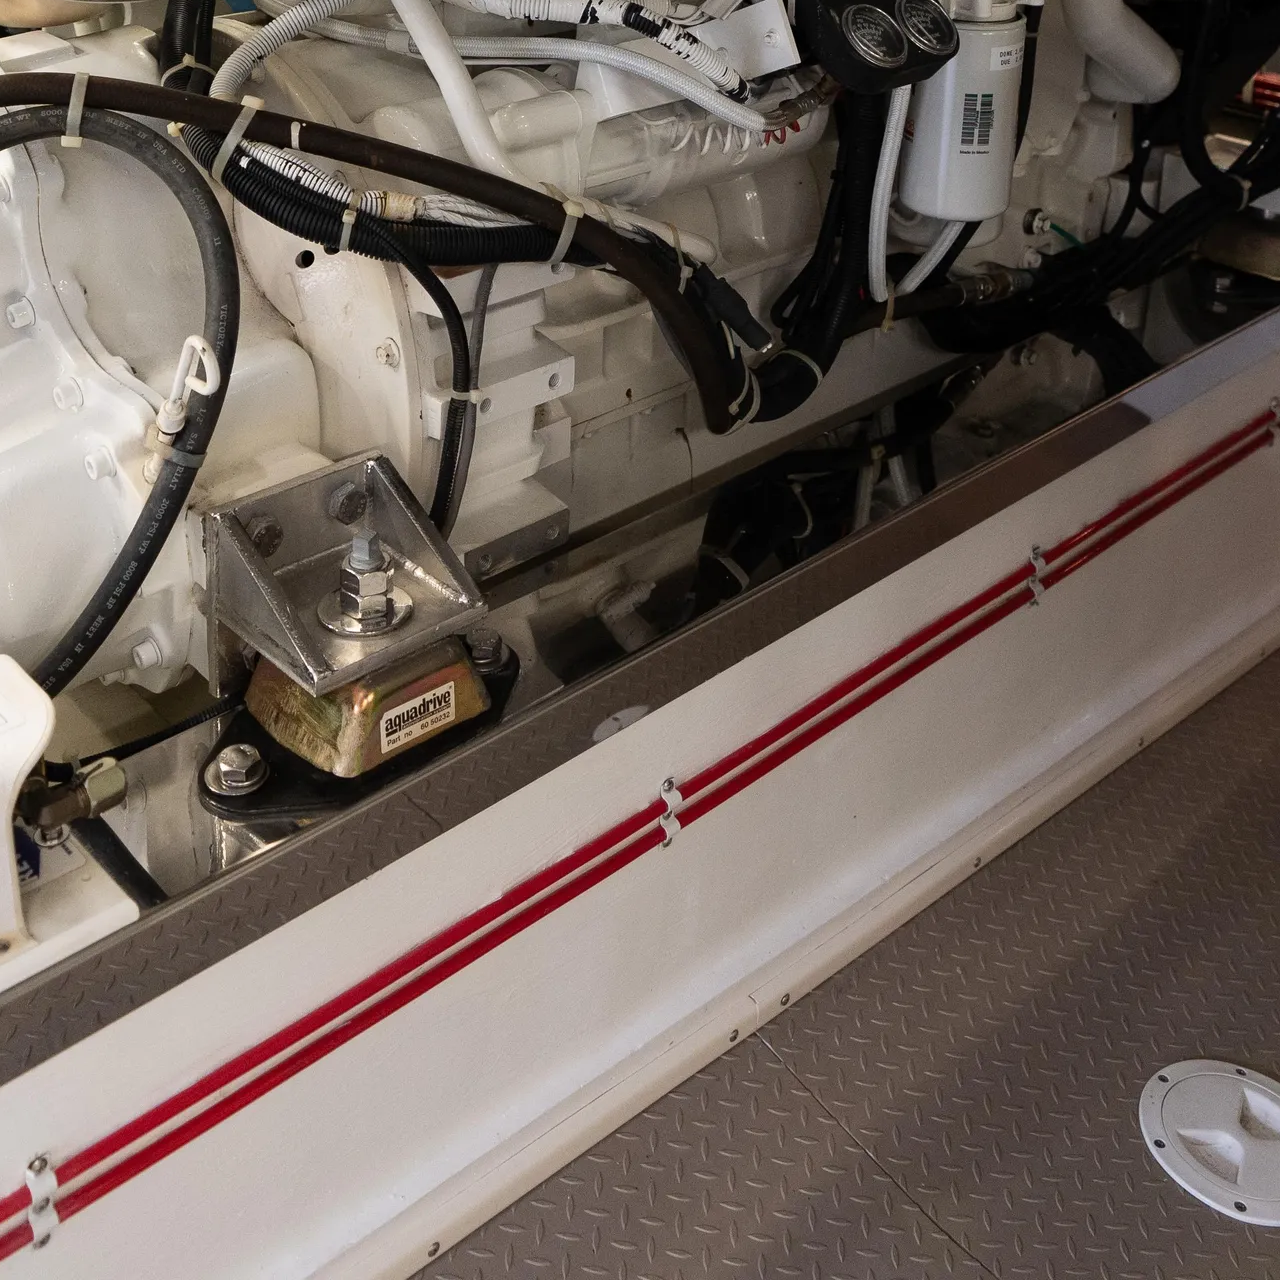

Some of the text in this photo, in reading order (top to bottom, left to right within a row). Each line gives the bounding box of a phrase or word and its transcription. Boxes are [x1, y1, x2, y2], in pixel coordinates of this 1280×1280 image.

[16, 112, 31, 122] WP
[40, 108, 62, 117] 8000
[105, 116, 130, 130] MEET
[136, 130, 147, 140] IN
[152, 139, 168, 156] USA
[171, 157, 186, 173] STD
[154, 497, 169, 519] 2000
[145, 520, 159, 537] PSI
[137, 538, 150, 555] WP
[121, 560, 137, 581] 8000
[111, 581, 125, 596] PSI
[104, 595, 116, 609] BP
[84, 614, 104, 638] MEET
[73, 642, 84, 653] IN
[57, 656, 72, 672] USA
[384, 690, 451, 732] aquadrive
[386, 711, 450, 746] Part no 60 50232
